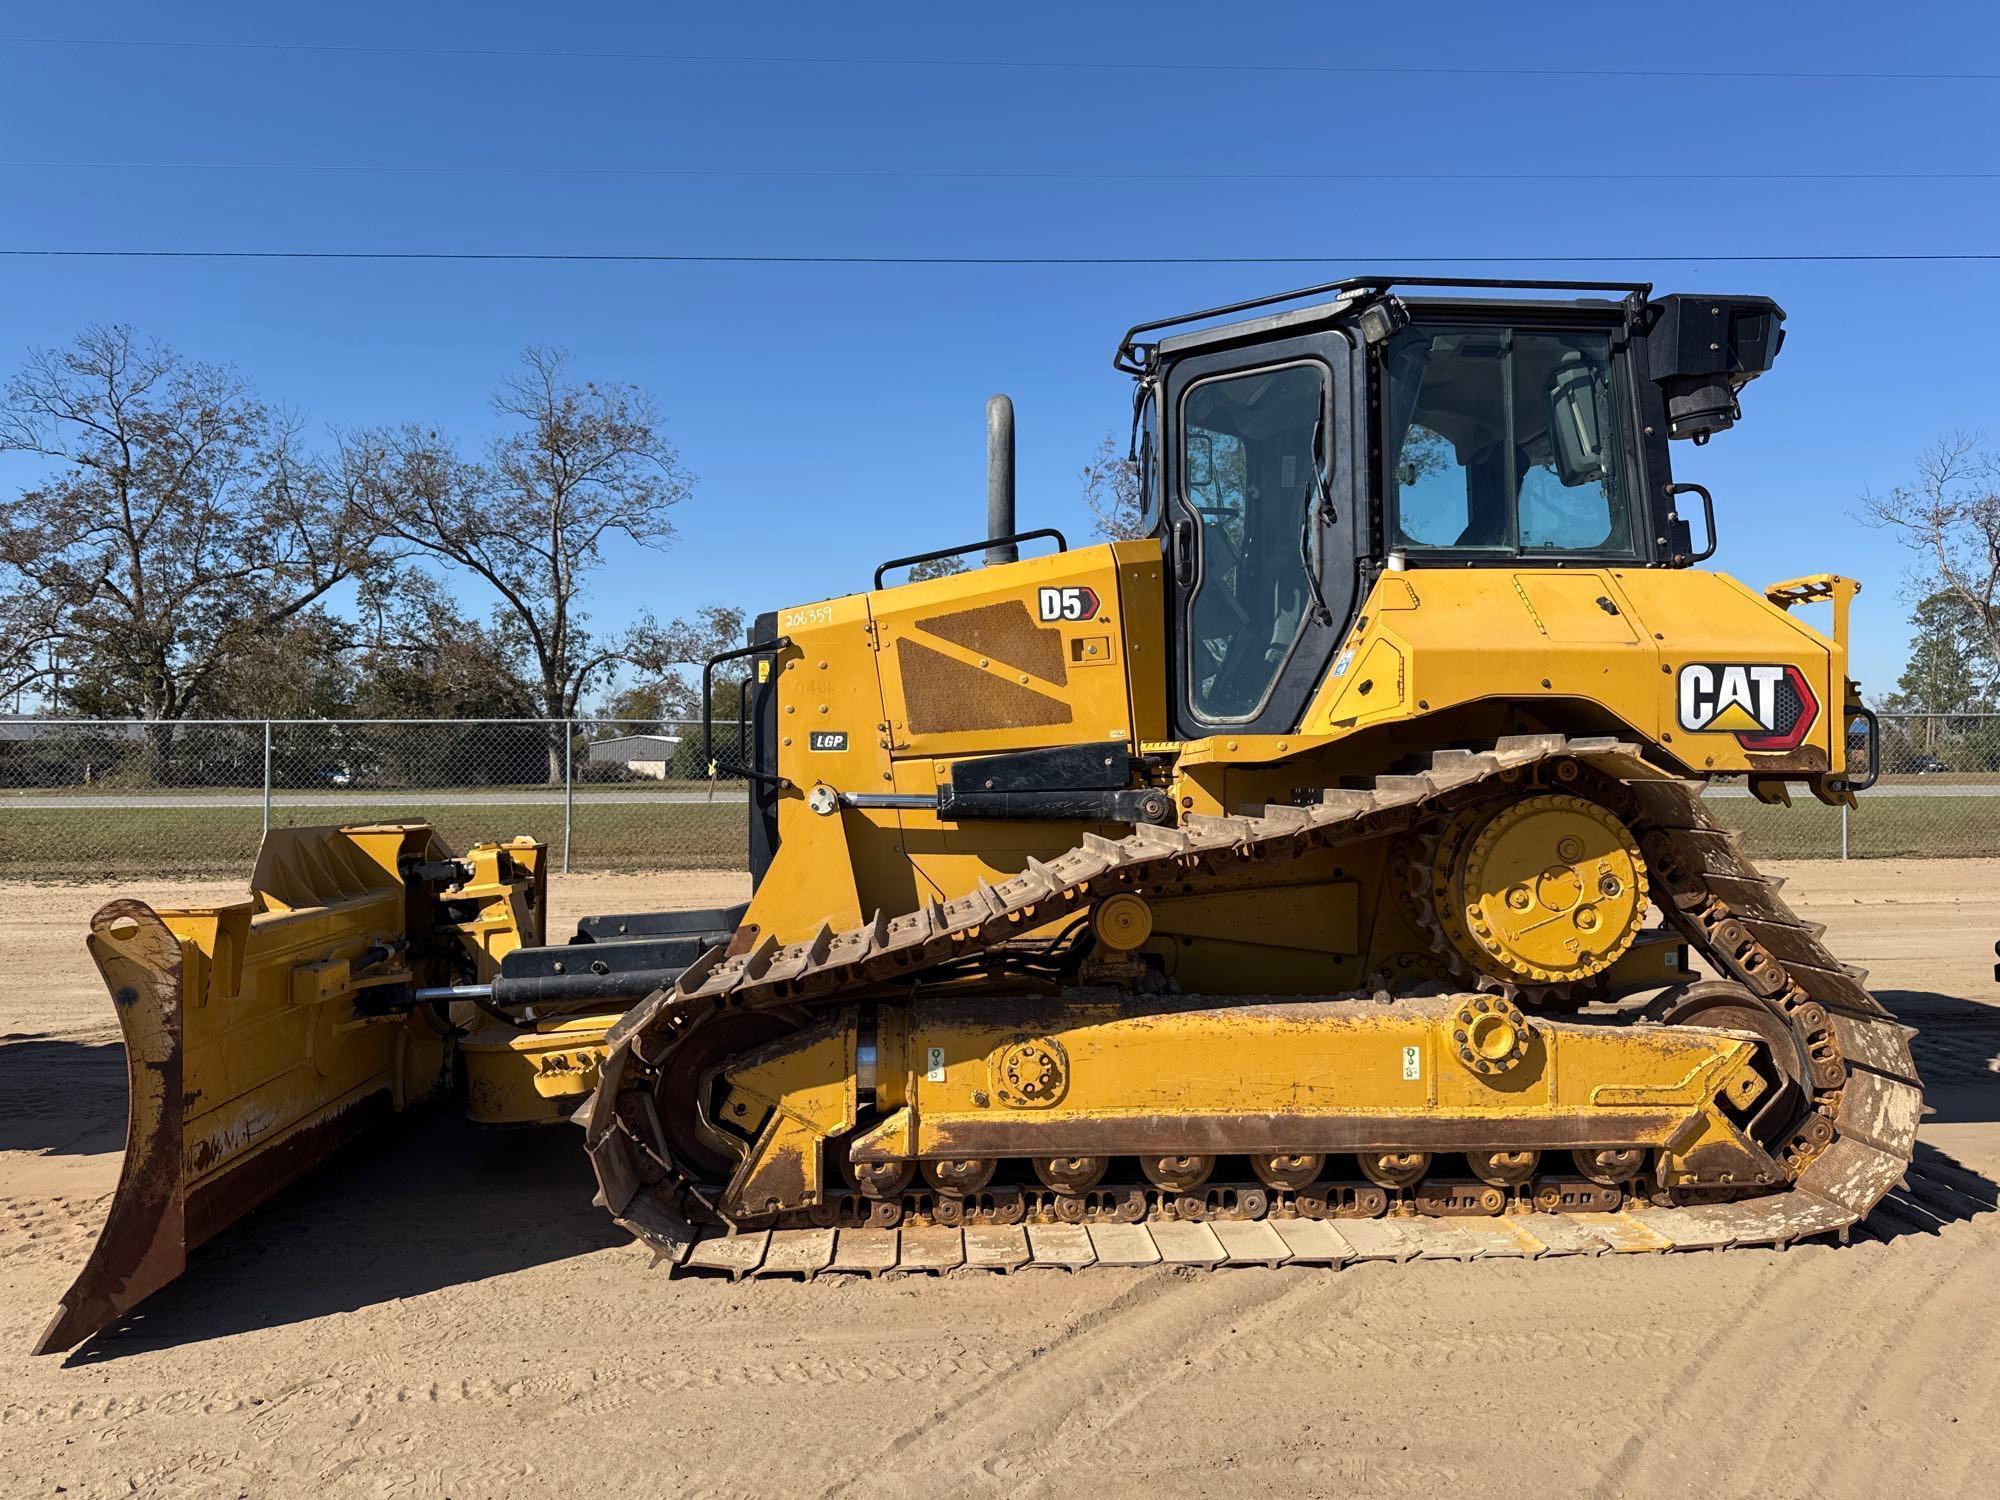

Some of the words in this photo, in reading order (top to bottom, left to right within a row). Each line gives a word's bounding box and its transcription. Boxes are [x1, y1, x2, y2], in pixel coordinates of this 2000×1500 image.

[785, 606, 832, 628] 206359
[1040, 588, 1081, 620] D5
[1680, 665, 1783, 730] CAT
[816, 735, 844, 748] LGP
